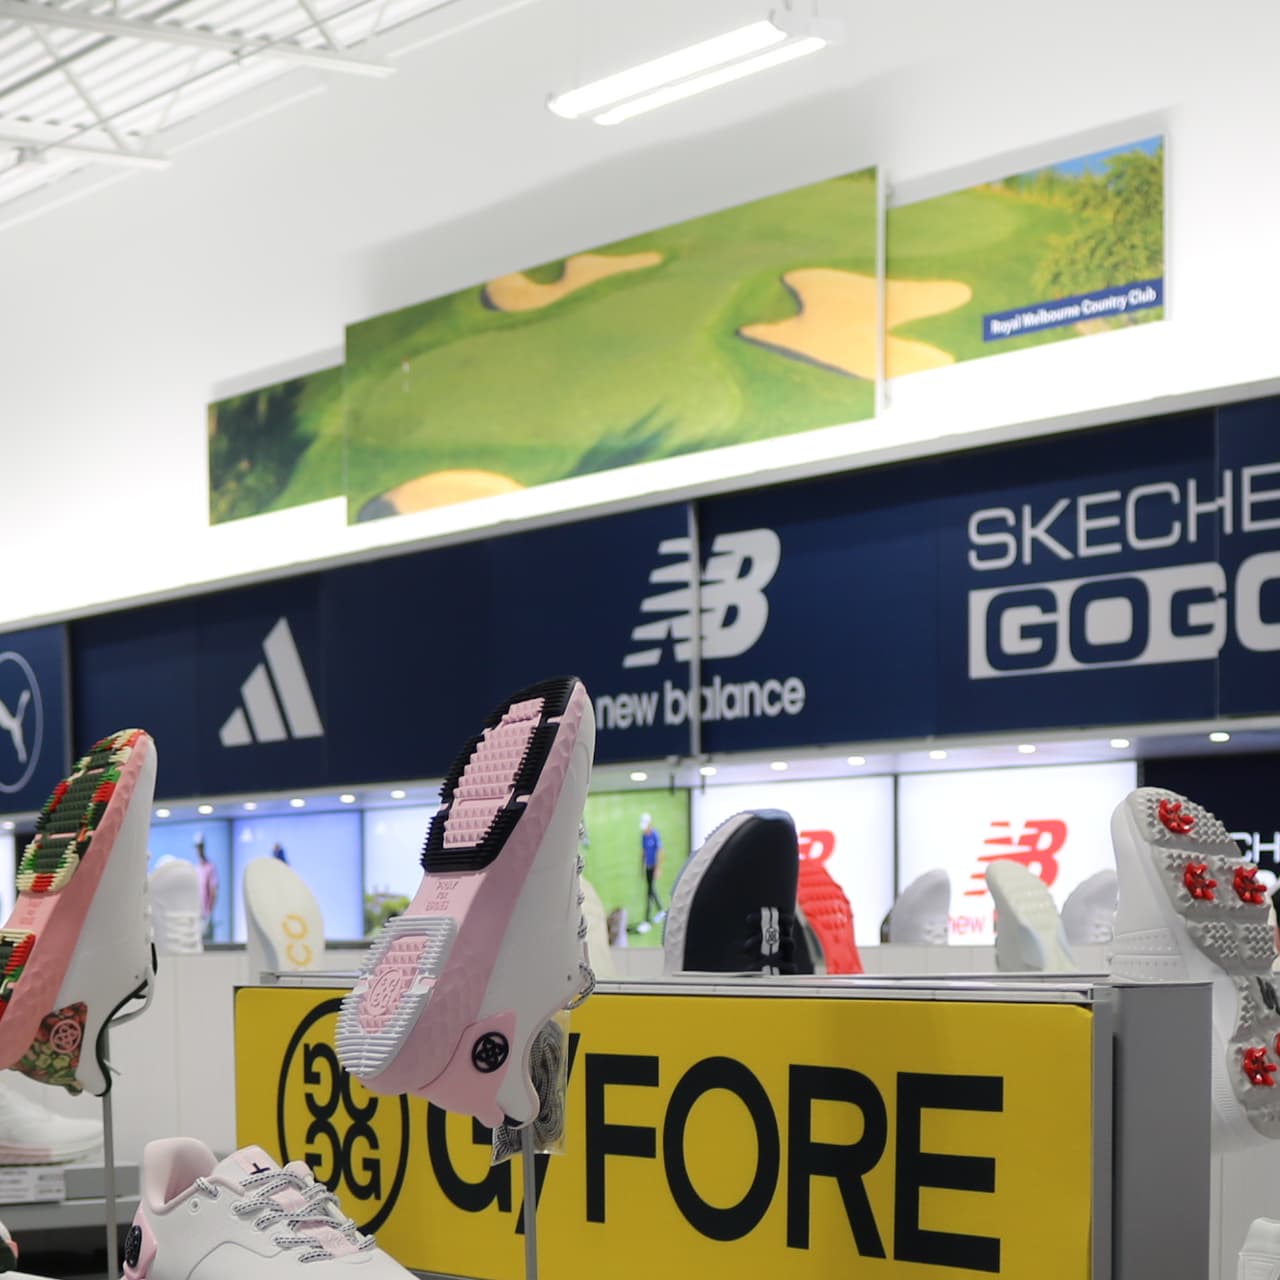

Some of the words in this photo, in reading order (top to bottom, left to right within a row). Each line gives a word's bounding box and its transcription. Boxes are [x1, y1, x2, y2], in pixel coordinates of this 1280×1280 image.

[990, 315, 1021, 335] Royal
[1023, 305, 1080, 328] Melbourne
[1081, 295, 1128, 314] Country
[1128, 286, 1157, 305] Club
[596, 690, 658, 731] new
[664, 677, 805, 726] balance
